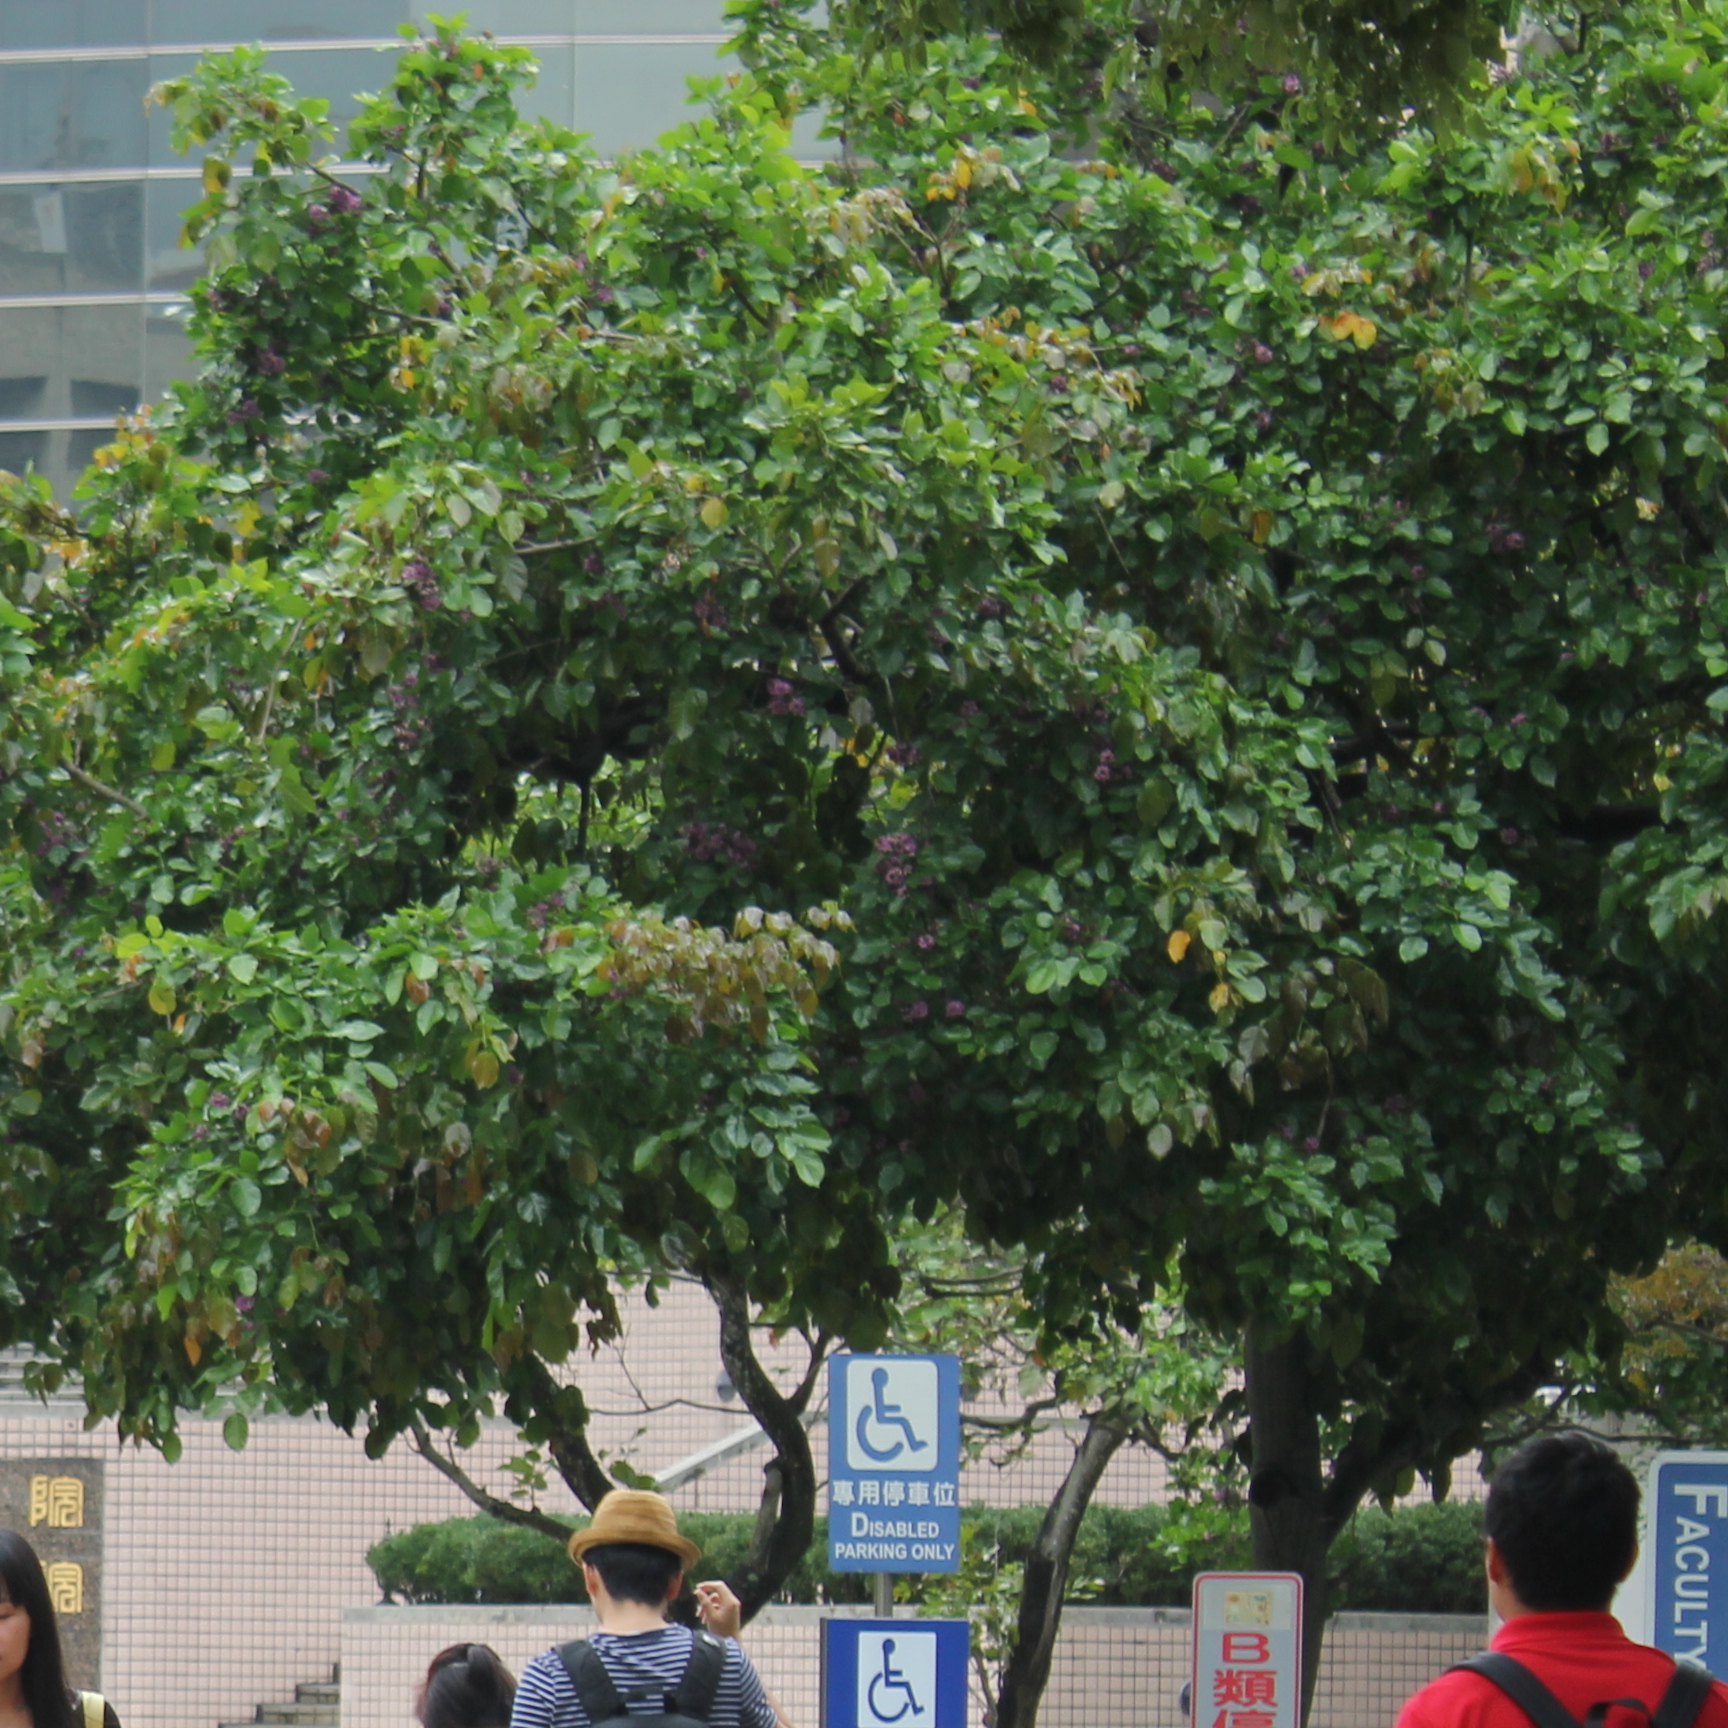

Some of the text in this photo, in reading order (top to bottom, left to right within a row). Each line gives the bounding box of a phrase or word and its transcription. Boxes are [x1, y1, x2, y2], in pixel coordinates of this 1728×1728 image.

[833, 1480, 956, 1507] 專用停車位
[851, 1511, 940, 1539] DISABLED
[835, 1542, 955, 1561] PARKING ONLY
